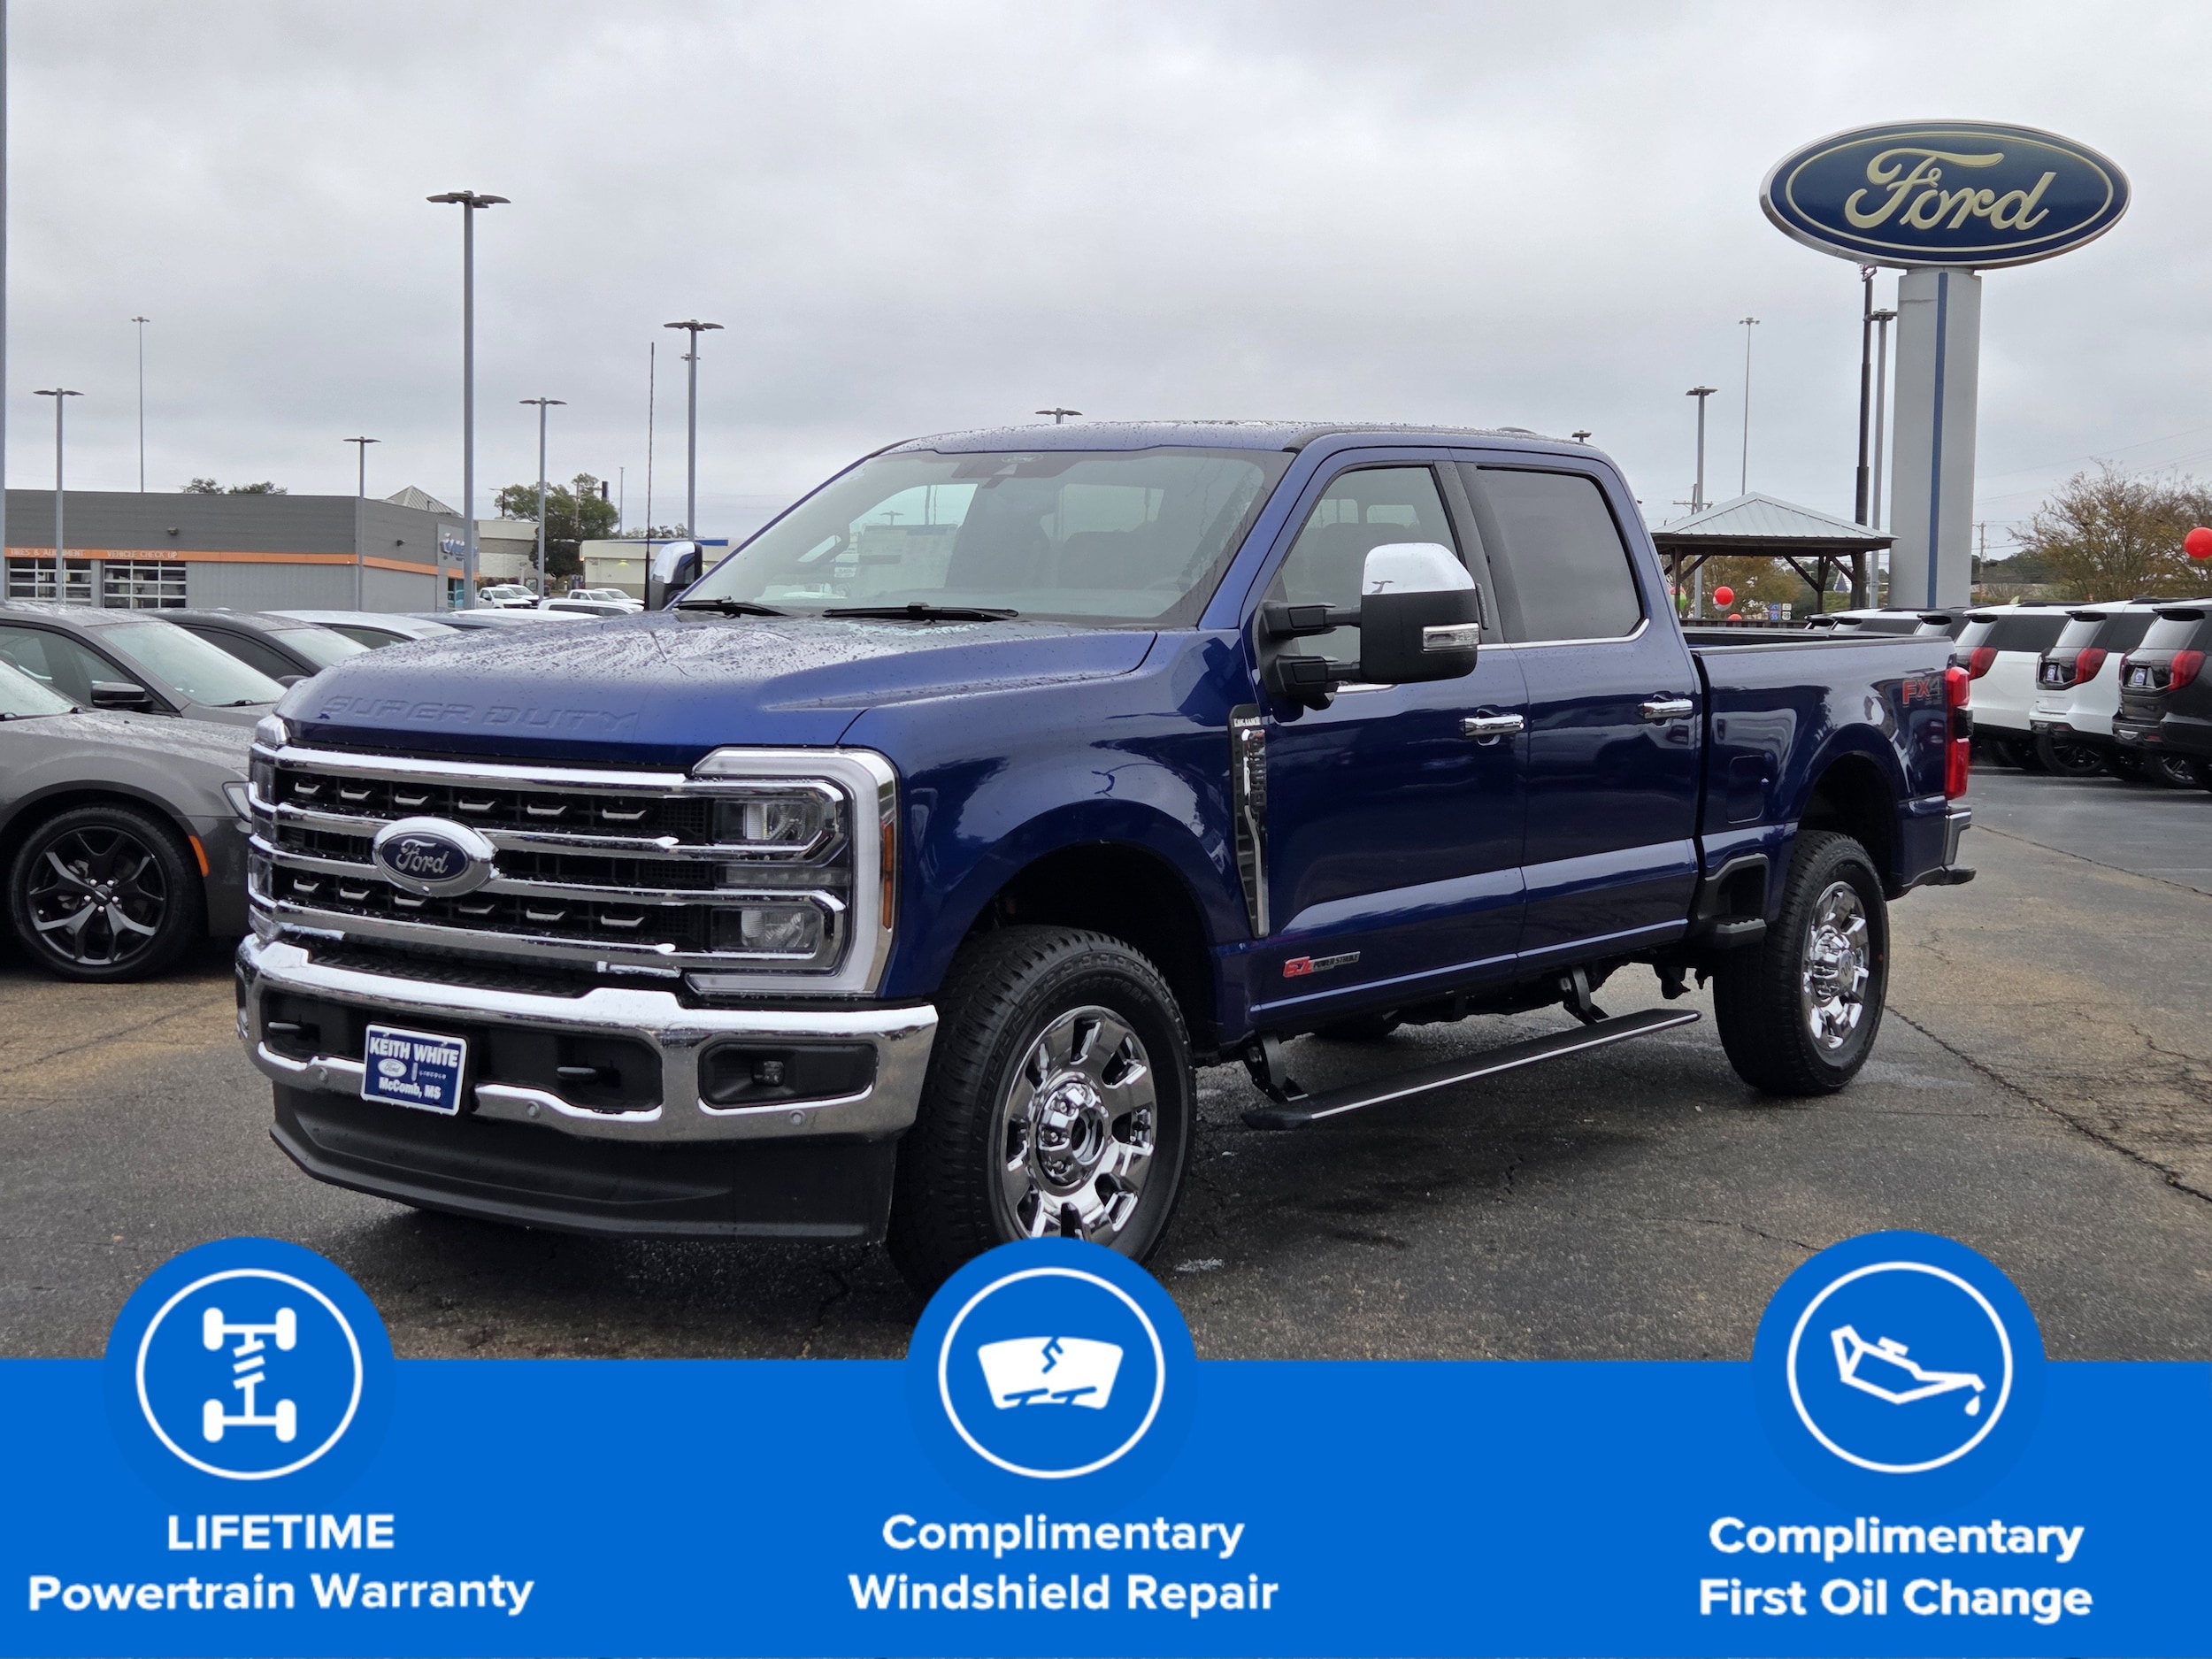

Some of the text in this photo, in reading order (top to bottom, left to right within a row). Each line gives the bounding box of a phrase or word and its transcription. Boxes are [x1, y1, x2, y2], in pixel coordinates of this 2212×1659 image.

[1845, 148, 2056, 230] Ford
[1902, 676, 1942, 707] FX4
[325, 695, 639, 733] SUPER DUTY
[396, 838, 450, 874] Ford
[1313, 958, 1334, 969] POWER
[369, 1037, 459, 1068] KEITH WHITE
[379, 1076, 442, 1100] McComb, MS
